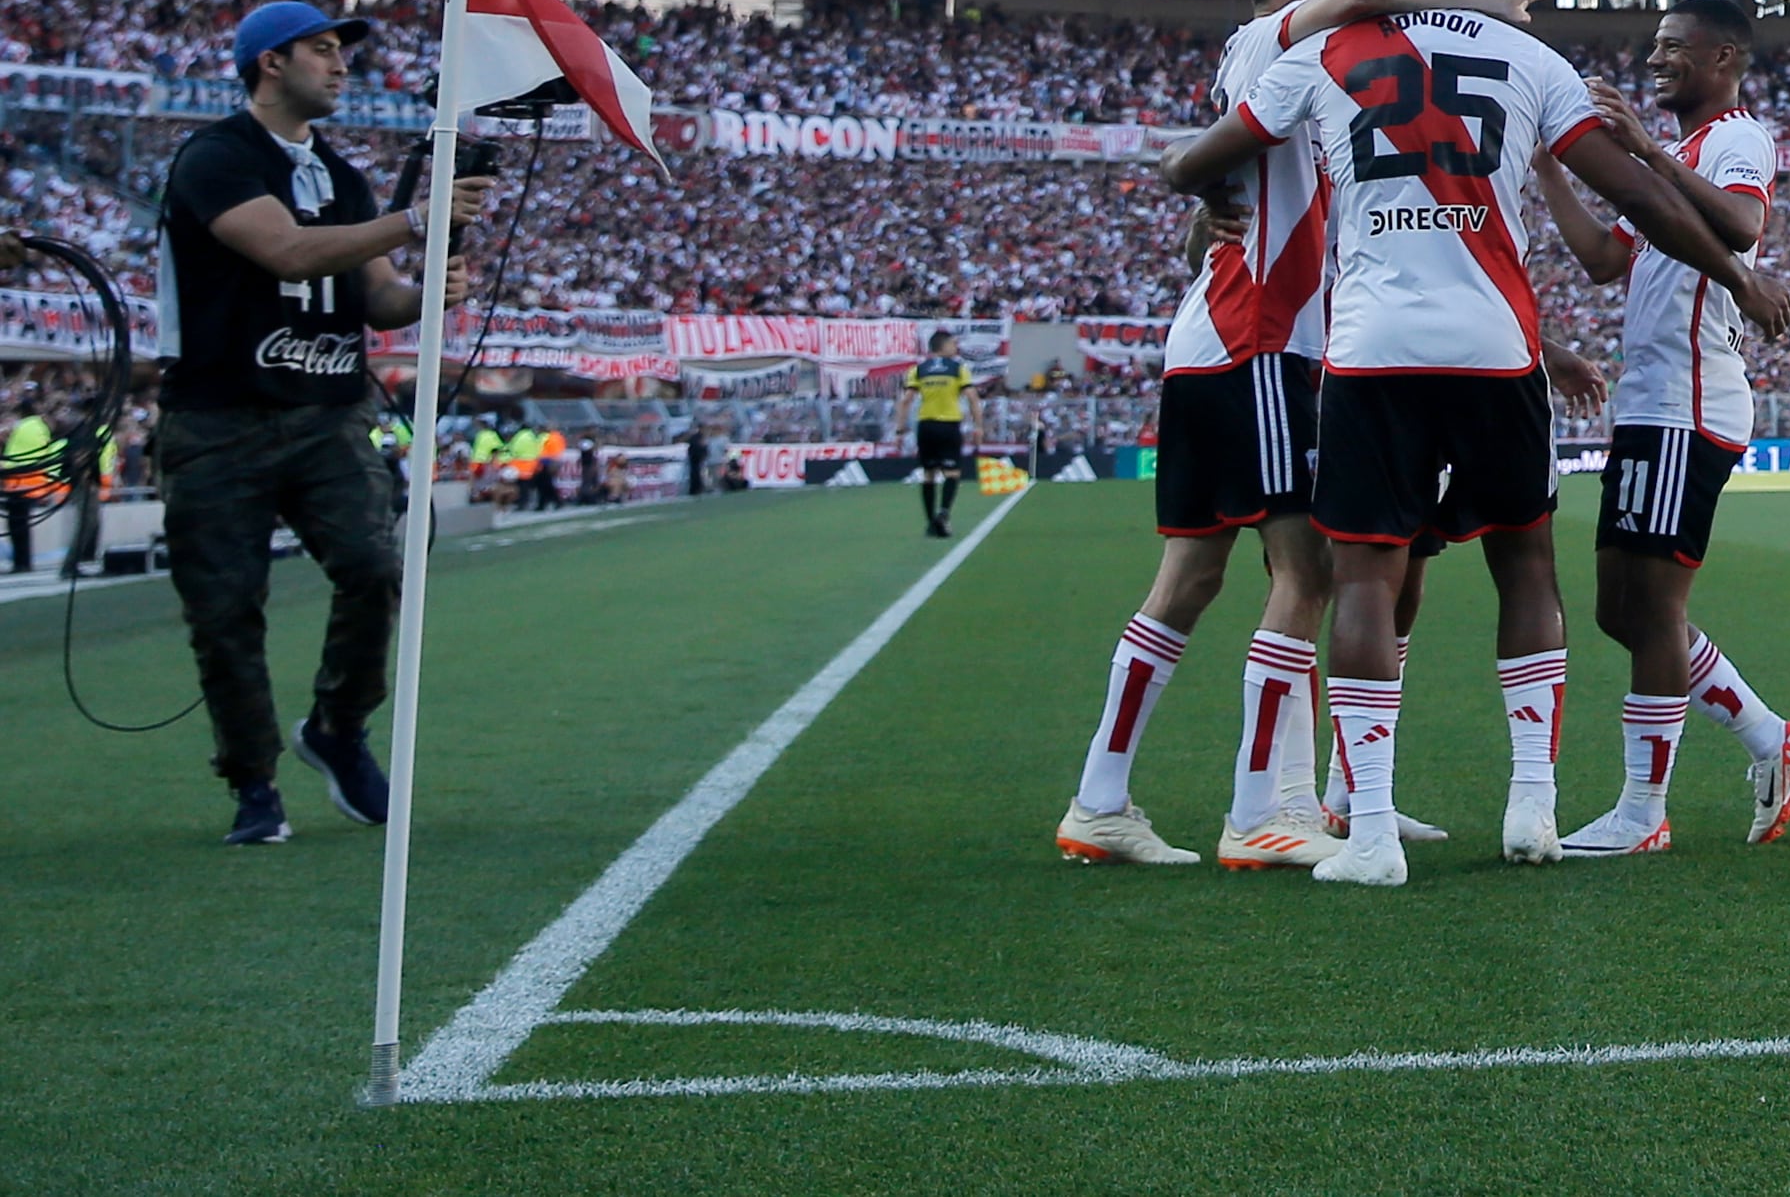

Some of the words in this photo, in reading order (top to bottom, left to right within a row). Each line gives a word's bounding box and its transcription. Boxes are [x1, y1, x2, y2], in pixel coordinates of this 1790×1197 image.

[711, 108, 900, 163] RINCON
[1345, 52, 1510, 183] 25
[1368, 205, 1489, 237] DIRECTV
[1618, 458, 1649, 514] 11
[1767, 445, 1780, 473] 1
